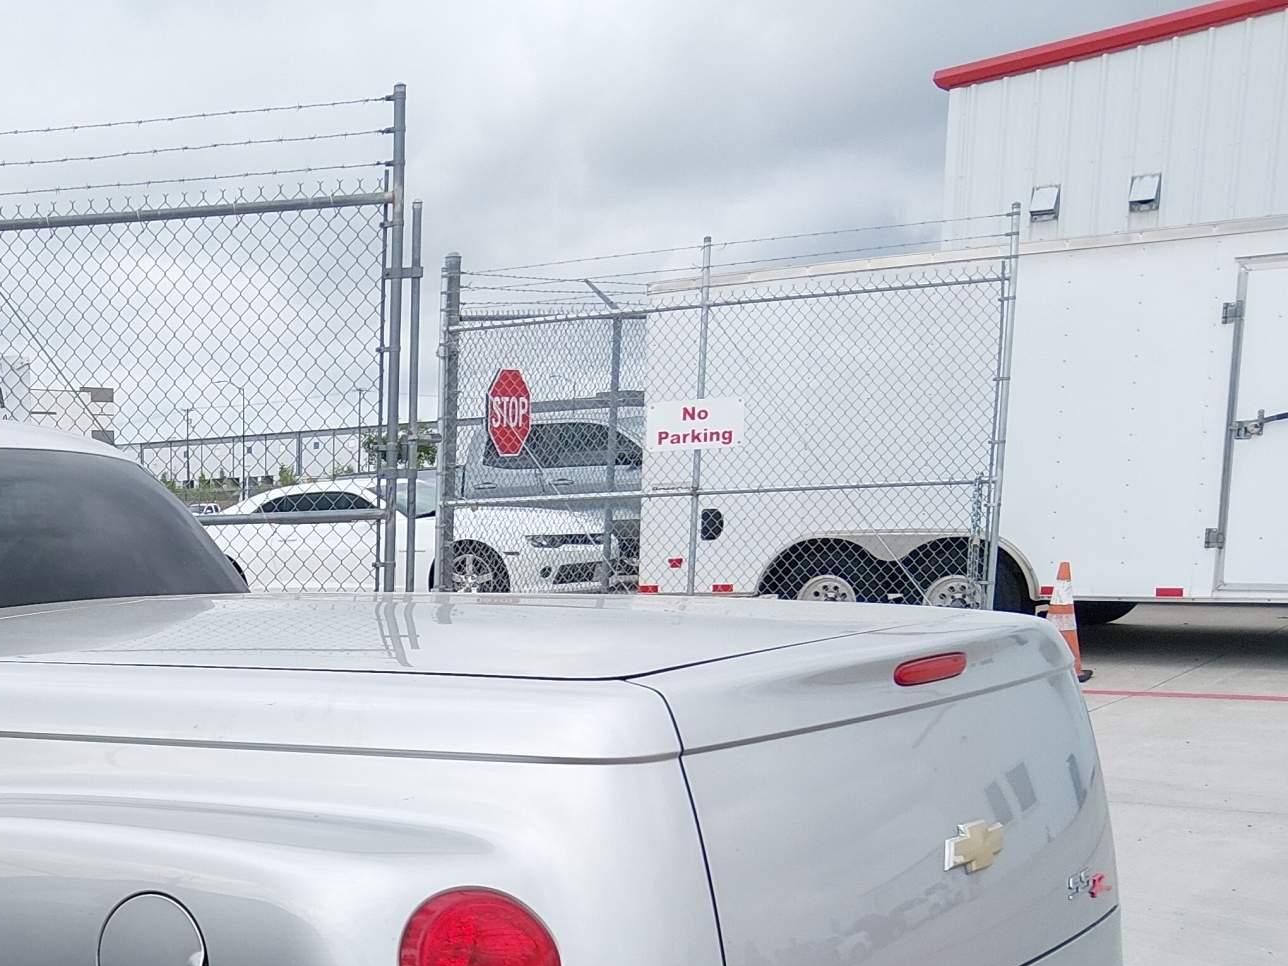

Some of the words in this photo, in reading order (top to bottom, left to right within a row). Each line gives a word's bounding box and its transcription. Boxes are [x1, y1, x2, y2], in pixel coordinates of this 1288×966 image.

[492, 396, 528, 427] STOP
[682, 406, 709, 421] No
[657, 429, 733, 445] Parking
